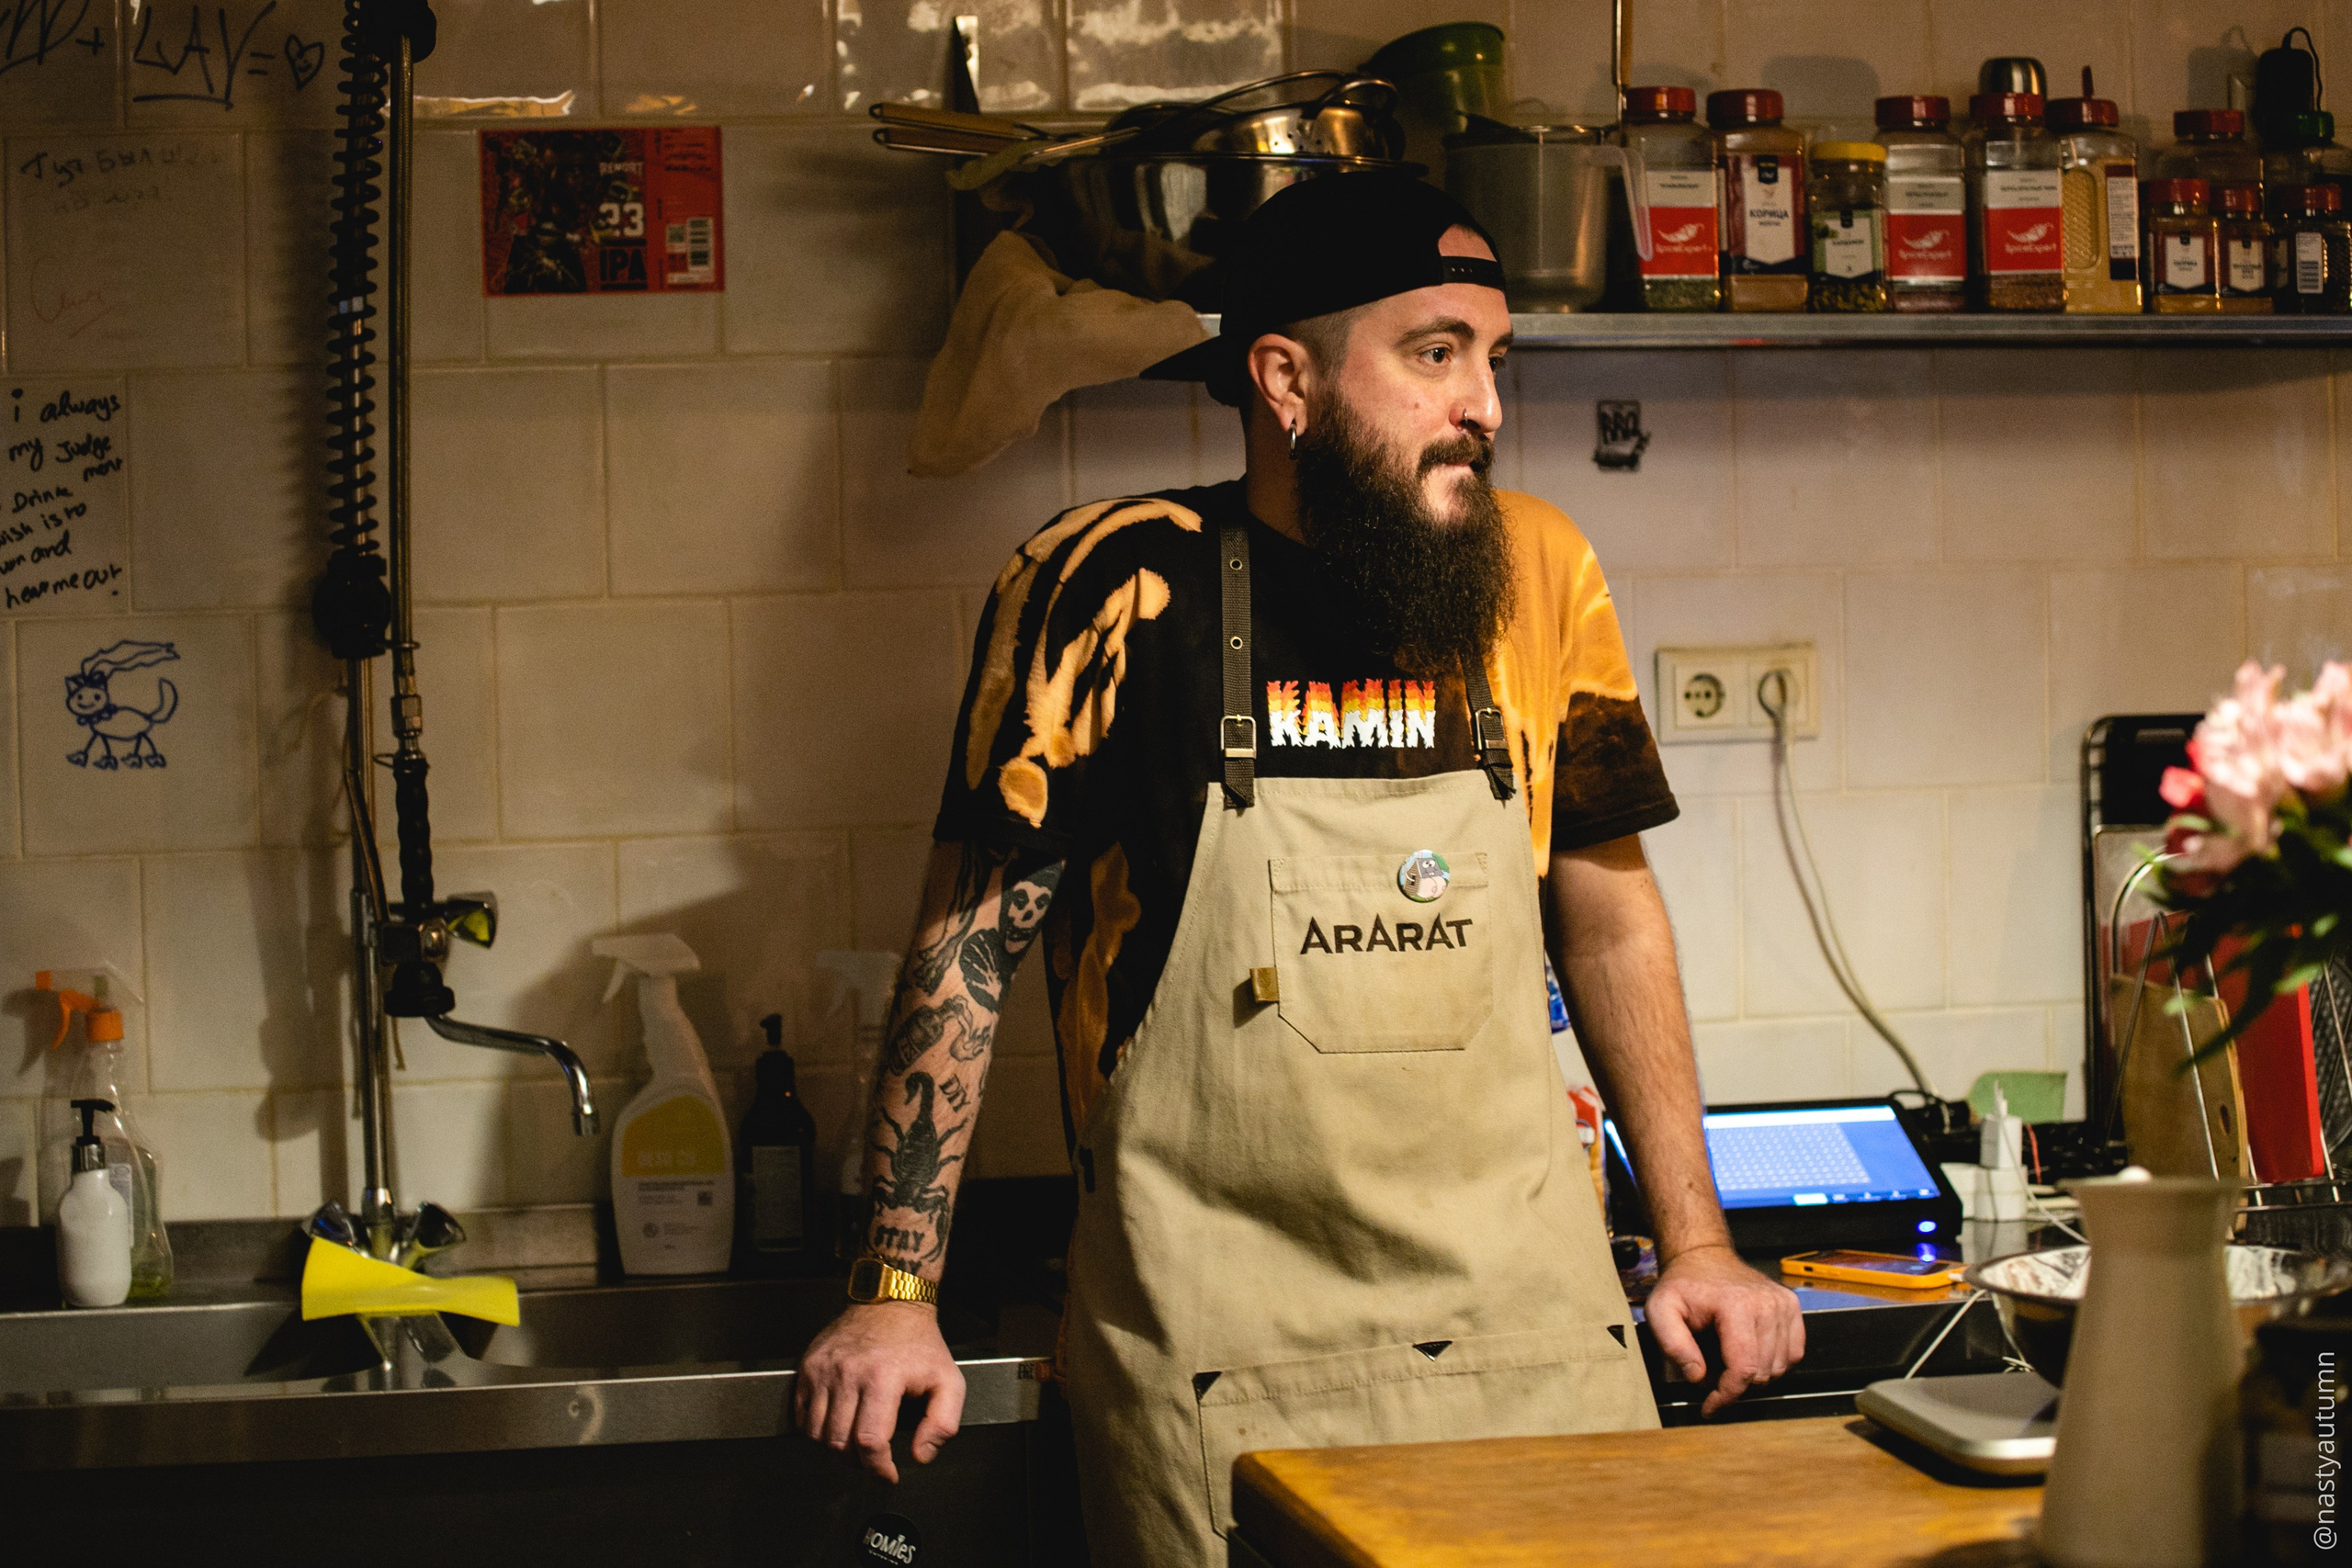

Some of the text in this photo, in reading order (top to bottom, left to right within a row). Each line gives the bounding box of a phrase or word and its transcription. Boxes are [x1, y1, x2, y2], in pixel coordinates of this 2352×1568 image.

[1749, 208, 1789, 220] КОРИЦА
[599, 247, 648, 282] IPA
[40, 390, 121, 423] always
[8, 437, 44, 472] my
[30, 529, 73, 564] and
[1266, 678, 1437, 750] KAMIN
[1299, 912, 1474, 955] ARARAT
[874, 1224, 926, 1255] STAY
